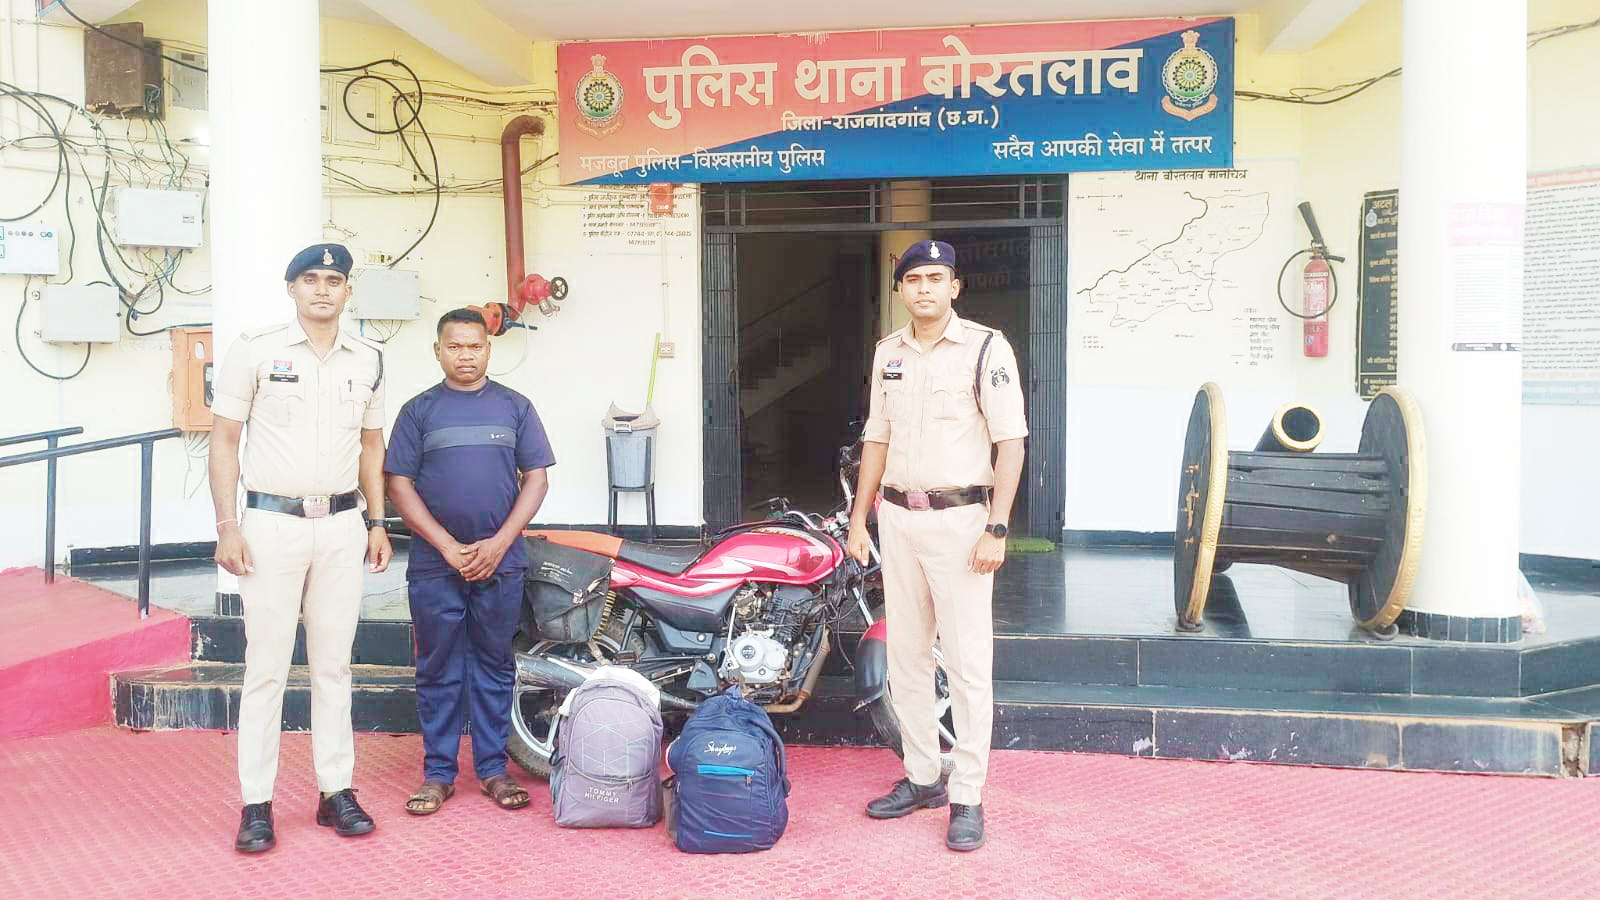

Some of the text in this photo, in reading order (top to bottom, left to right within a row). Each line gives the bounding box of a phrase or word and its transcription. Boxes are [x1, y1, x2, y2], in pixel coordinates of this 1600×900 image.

[643, 34, 1143, 129] पुलिस थाना बोरतलाव
[937, 105, 999, 131] (छ.ग.)
[992, 130, 1213, 161] सदैव आपकी सेवा में तत्पर
[580, 156, 630, 178] मजबूत
[777, 143, 826, 174] पुलिस
[1134, 169, 1159, 182] थाना
[584, 791, 620, 804] HILFIGER
[589, 786, 618, 797] TOMMY
